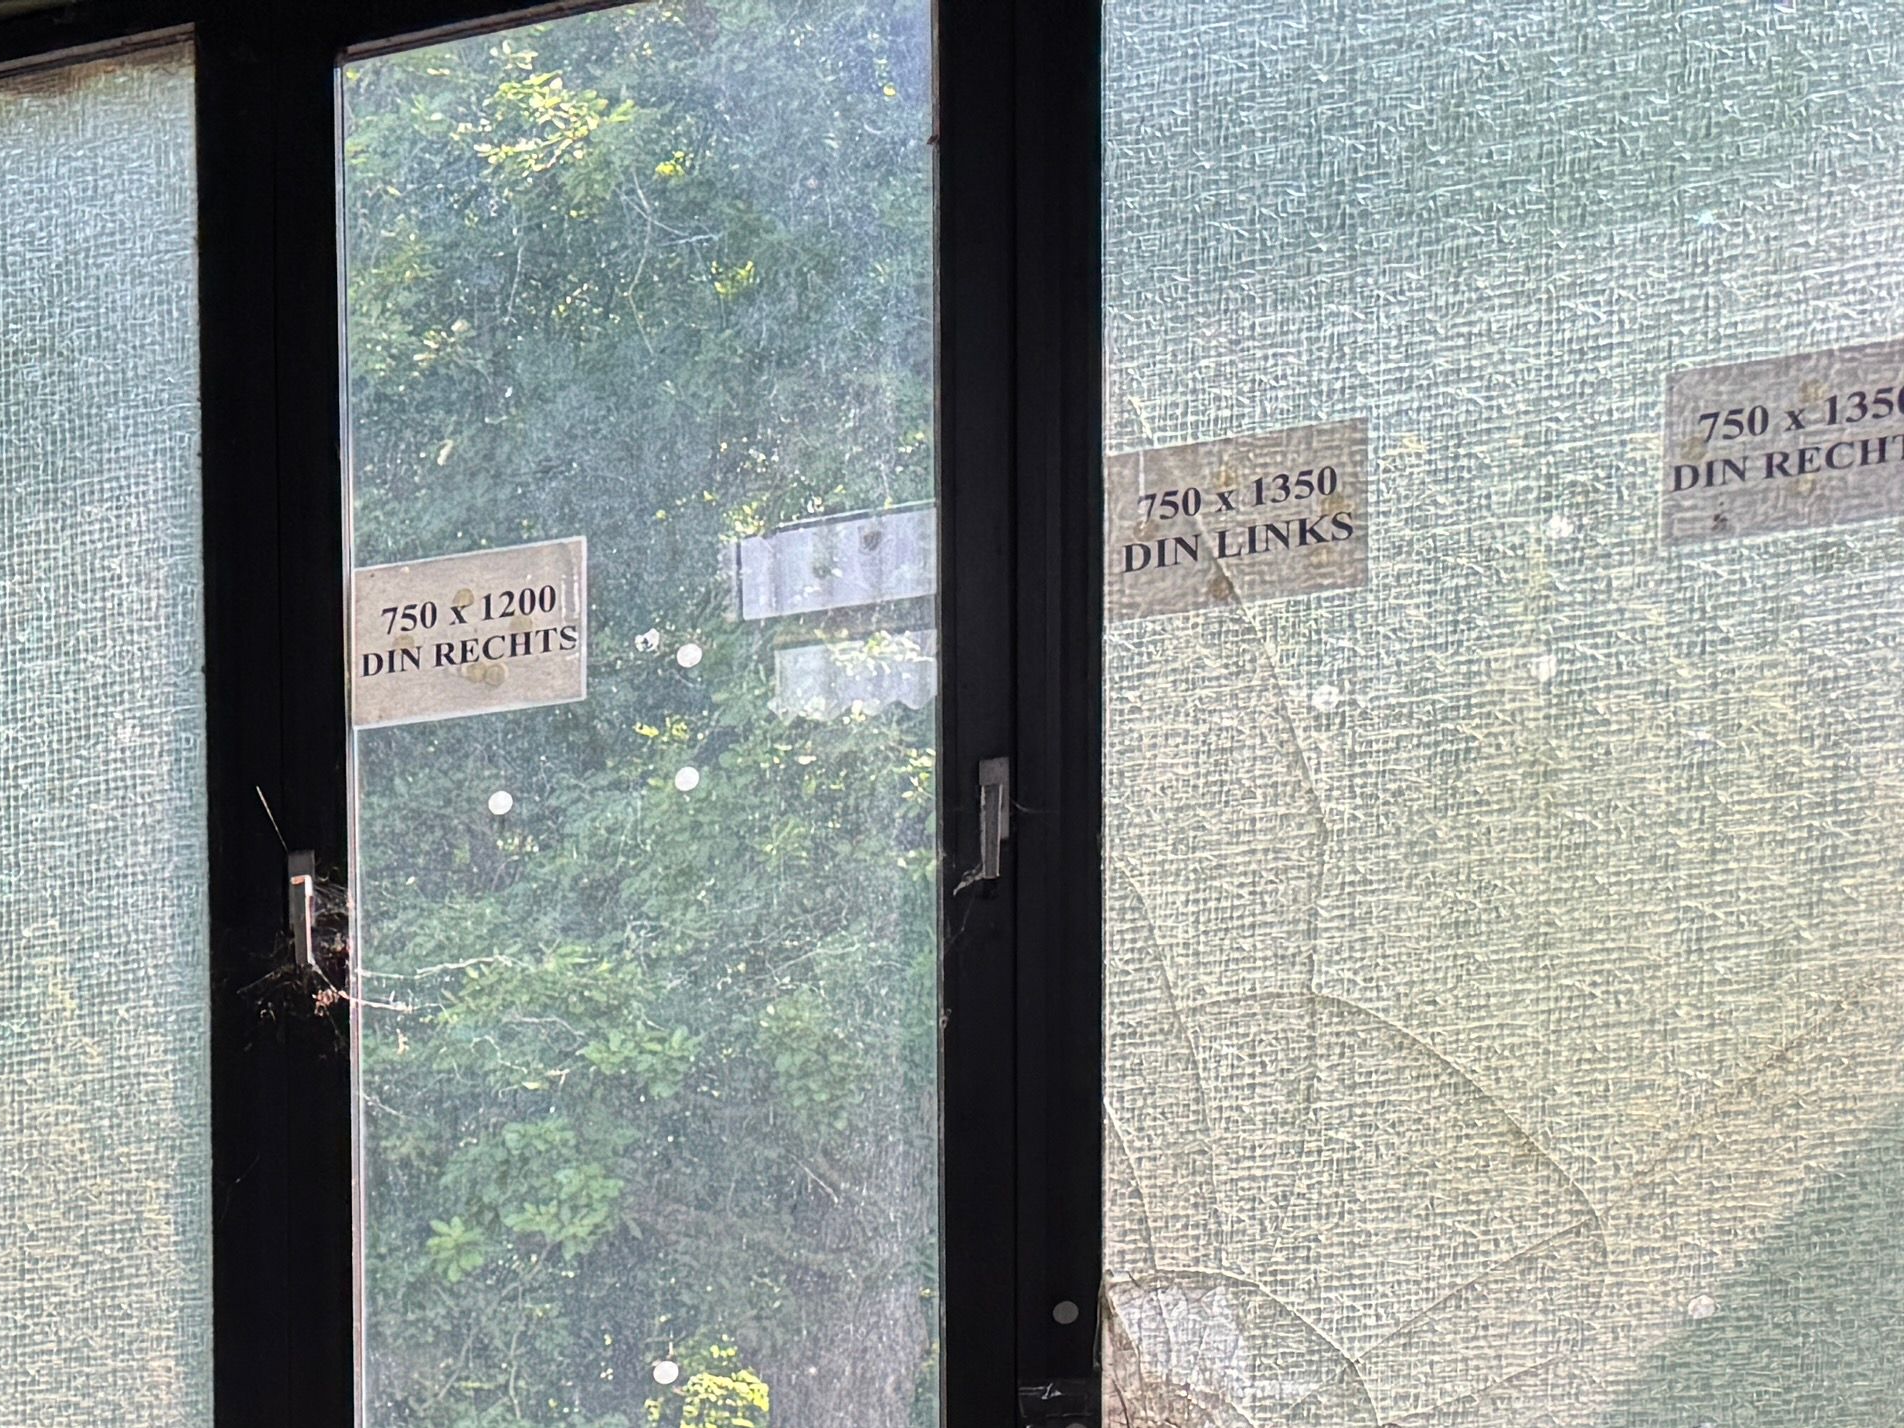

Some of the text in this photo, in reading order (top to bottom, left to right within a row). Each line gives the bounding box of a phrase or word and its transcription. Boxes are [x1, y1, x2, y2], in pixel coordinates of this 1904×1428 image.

[1697, 404, 1769, 444] 750
[1784, 407, 1806, 432] x
[1137, 465, 1338, 525] 750 x 1350
[1672, 455, 1748, 492] DIN
[1122, 511, 1354, 573] DIN LINKS
[381, 584, 557, 635] 750 x 1200
[361, 625, 578, 678] DIN RECHTS
